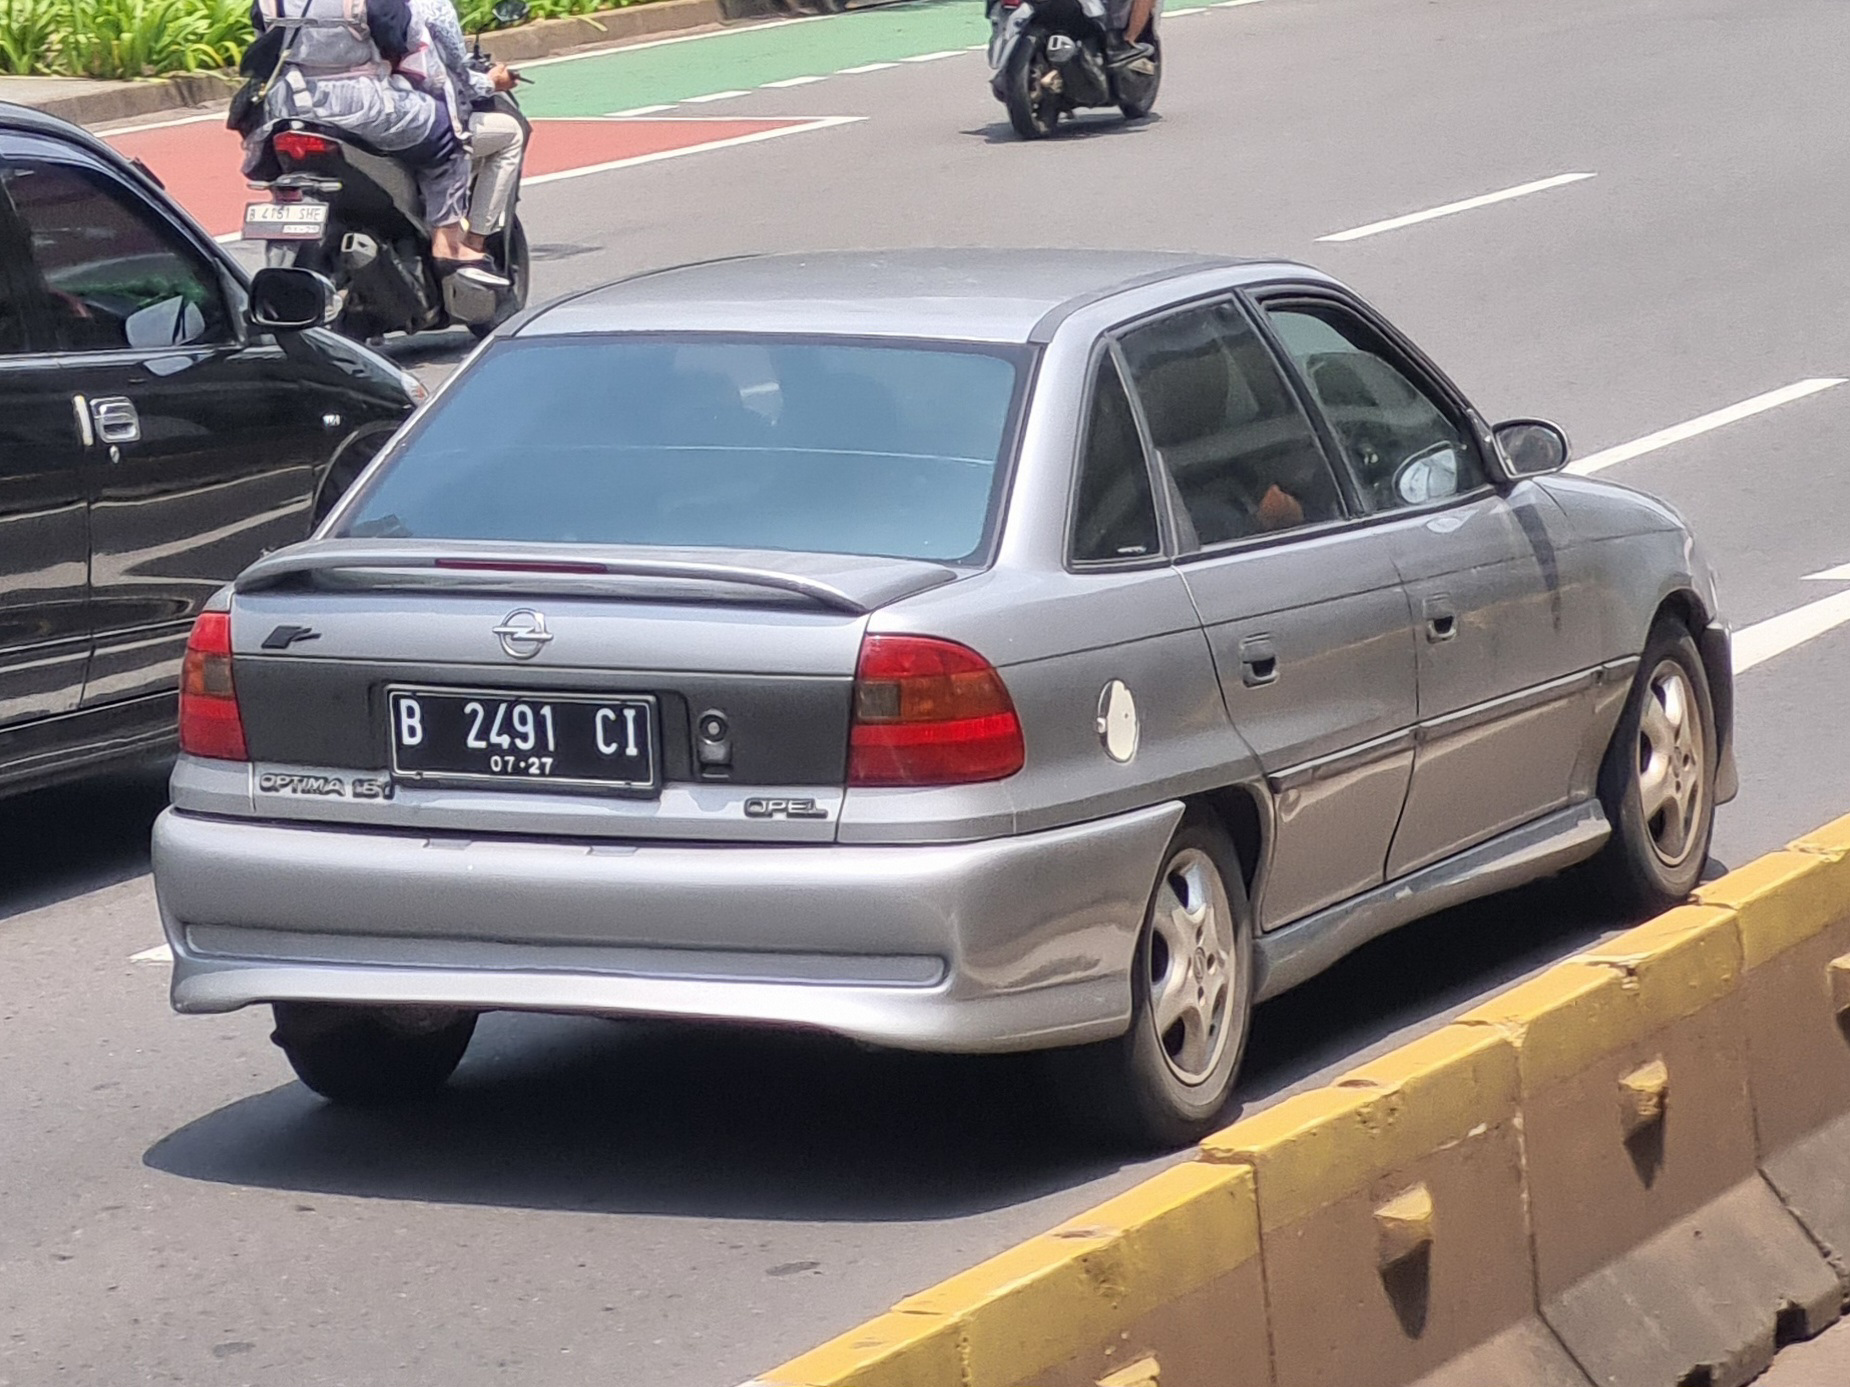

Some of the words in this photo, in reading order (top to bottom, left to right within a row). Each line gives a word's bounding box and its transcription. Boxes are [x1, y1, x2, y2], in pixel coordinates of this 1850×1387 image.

[399, 698, 423, 745] B
[463, 701, 555, 751] 2491
[595, 708, 639, 756] CI
[260, 773, 346, 797] OPTIMA
[744, 798, 829, 819] OPEL
